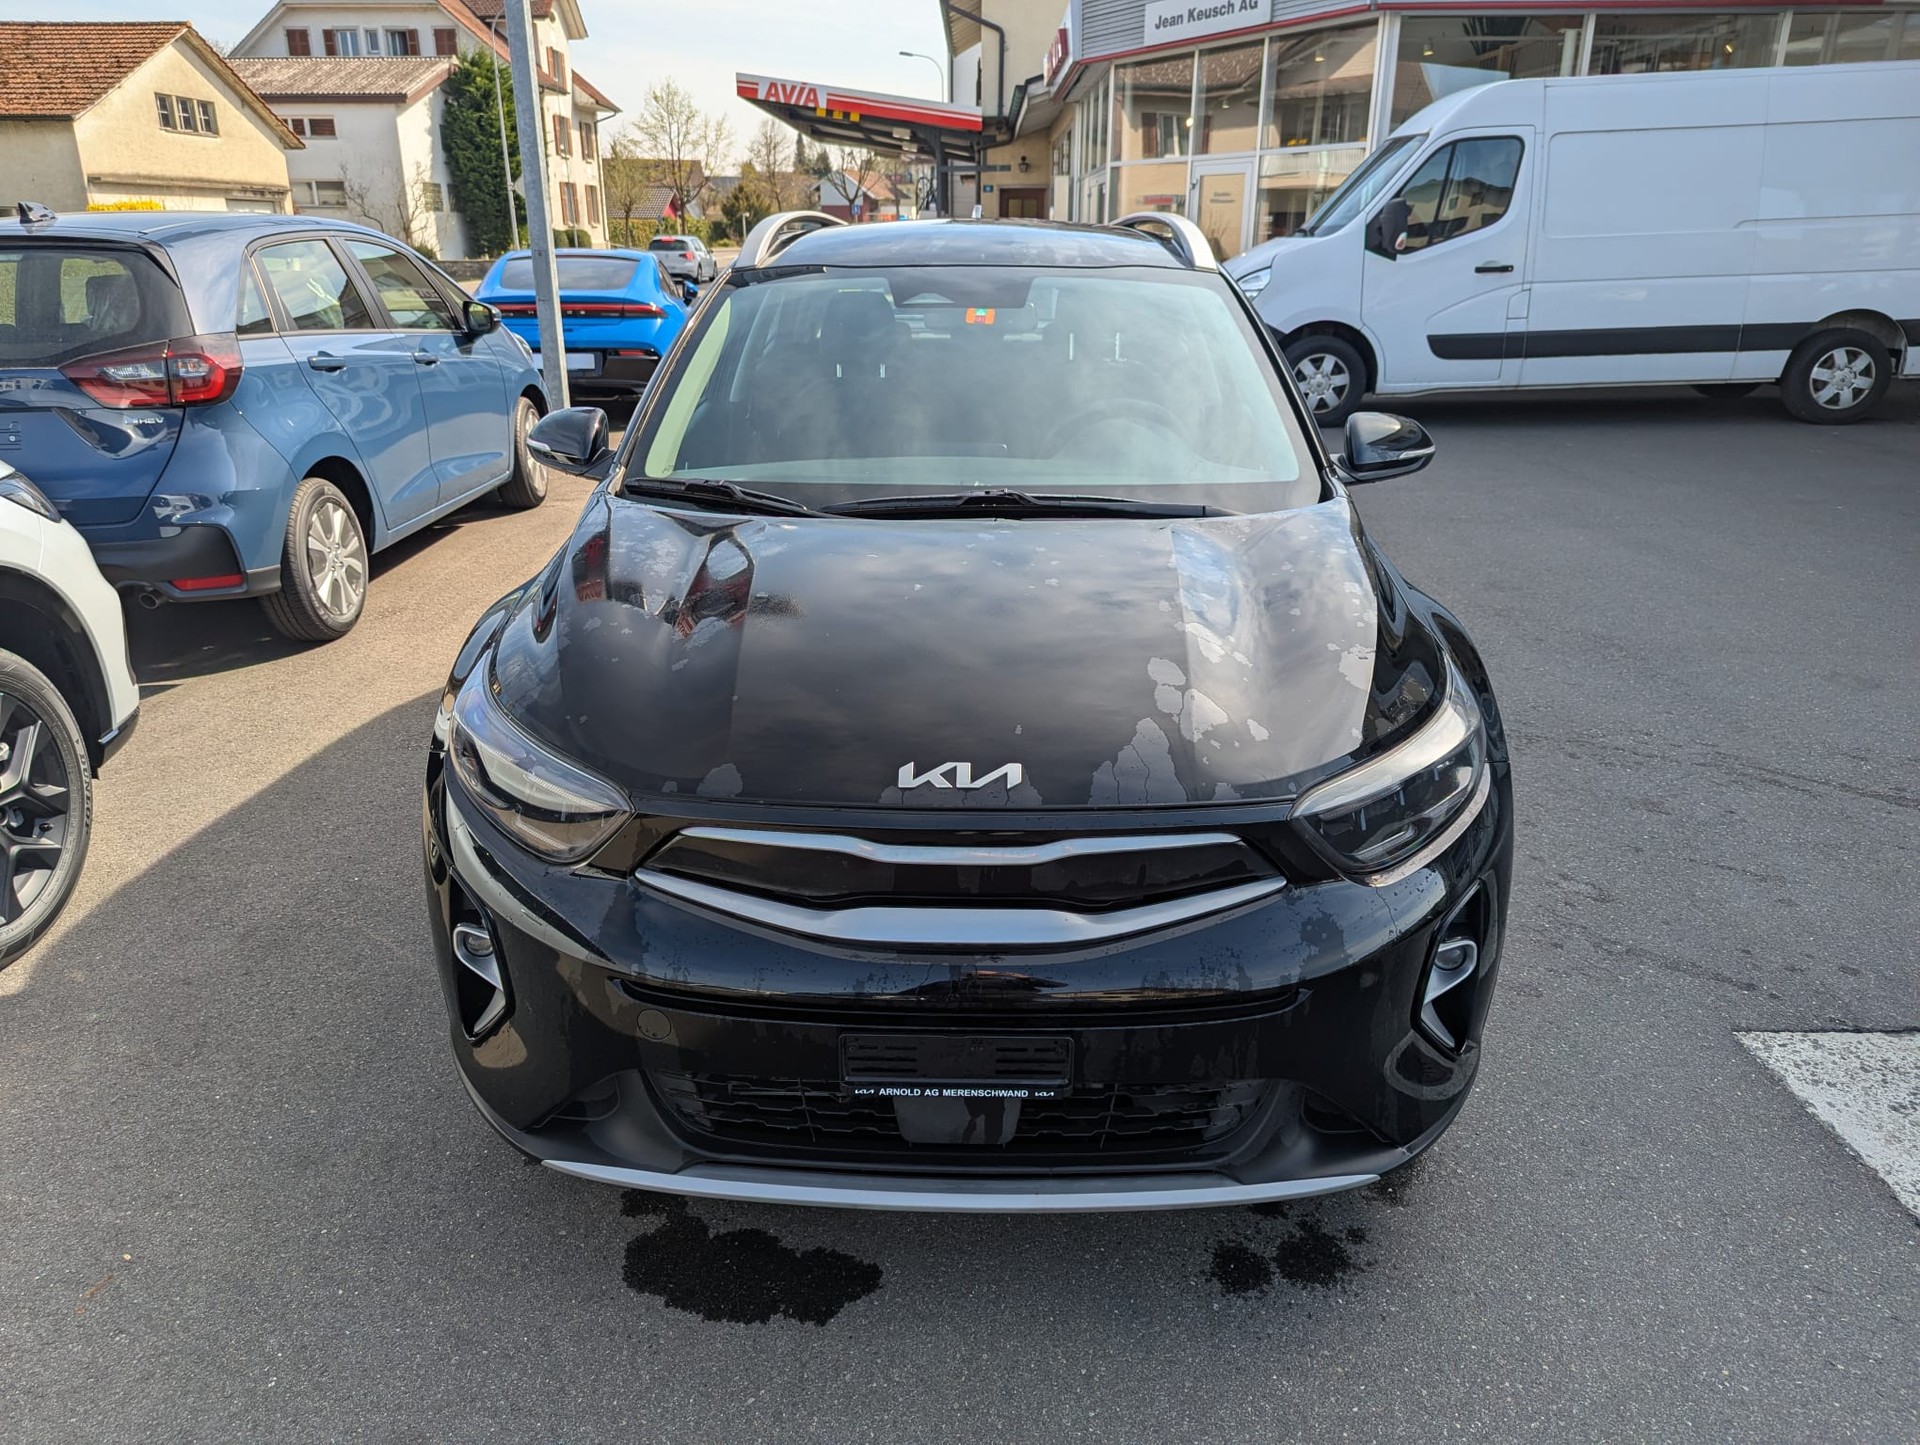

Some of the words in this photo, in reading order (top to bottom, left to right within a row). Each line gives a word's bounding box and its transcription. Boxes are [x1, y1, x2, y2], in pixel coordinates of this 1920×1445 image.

[1155, 14, 1184, 30] Jean
[1187, 0, 1235, 23] Keusch
[1239, 0, 1259, 13] AG
[764, 81, 820, 107] AVIA
[898, 761, 1022, 789] KIA
[79, 752, 92, 836] DUNLOP
[879, 1087, 921, 1096] ARNOLD
[924, 1088, 939, 1097] AG
[942, 1088, 1029, 1098] MERENSCHWAND
